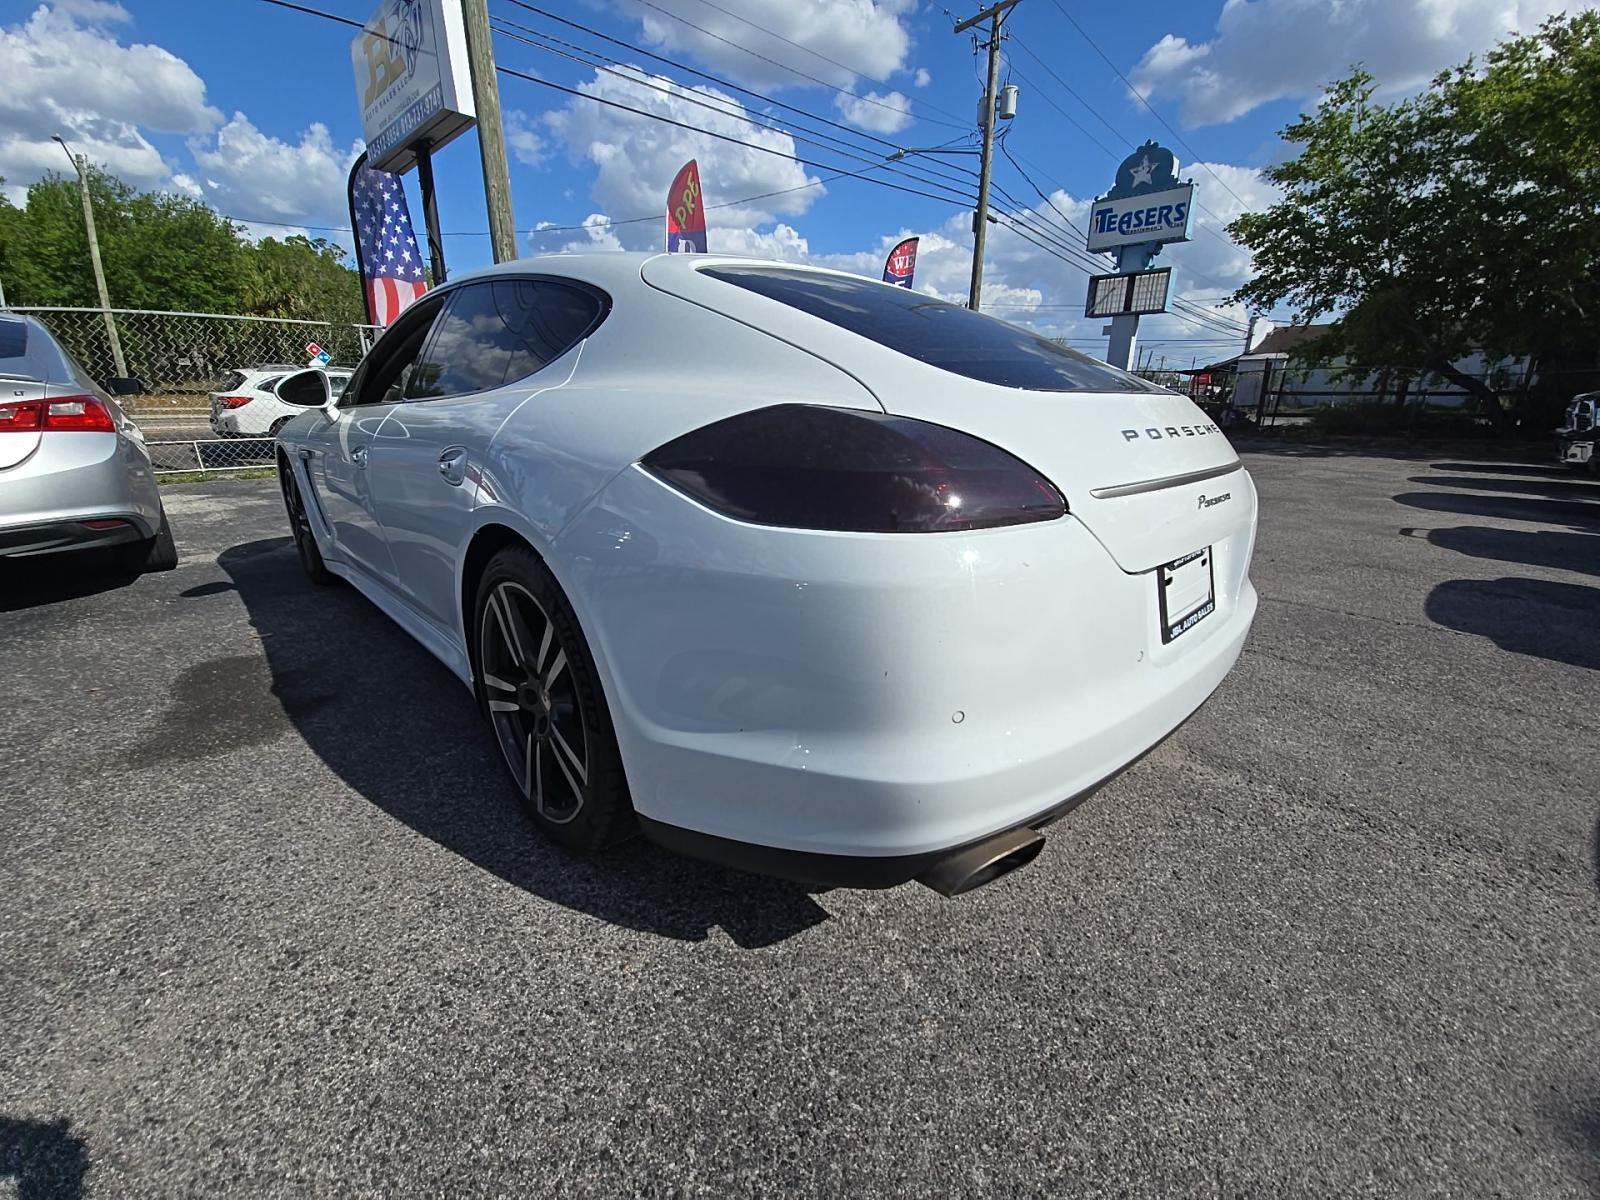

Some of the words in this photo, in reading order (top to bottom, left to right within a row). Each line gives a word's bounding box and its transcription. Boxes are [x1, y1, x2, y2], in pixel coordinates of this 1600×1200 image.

[1096, 202, 1186, 235] TEASERS
[1121, 423, 1220, 442] PORSCHE
[1170, 624, 1183, 639] JBL
[1183, 613, 1197, 630] AUTO
[1198, 602, 1214, 619] SALES
